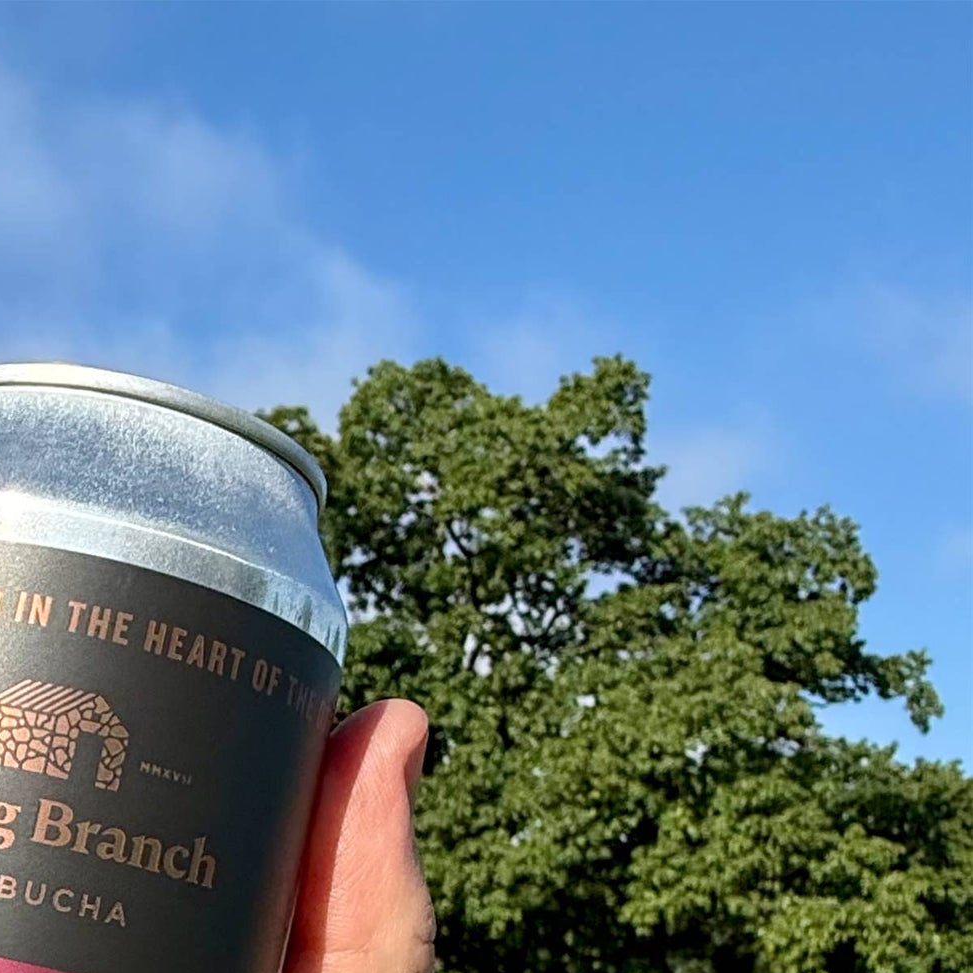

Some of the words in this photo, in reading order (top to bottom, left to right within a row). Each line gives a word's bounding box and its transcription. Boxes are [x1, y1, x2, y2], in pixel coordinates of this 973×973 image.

[13, 591, 53, 627] IN
[69, 601, 134, 645] THE
[144, 620, 246, 680] HEART
[252, 659, 282, 696] OF
[30, 798, 218, 889] Branch
